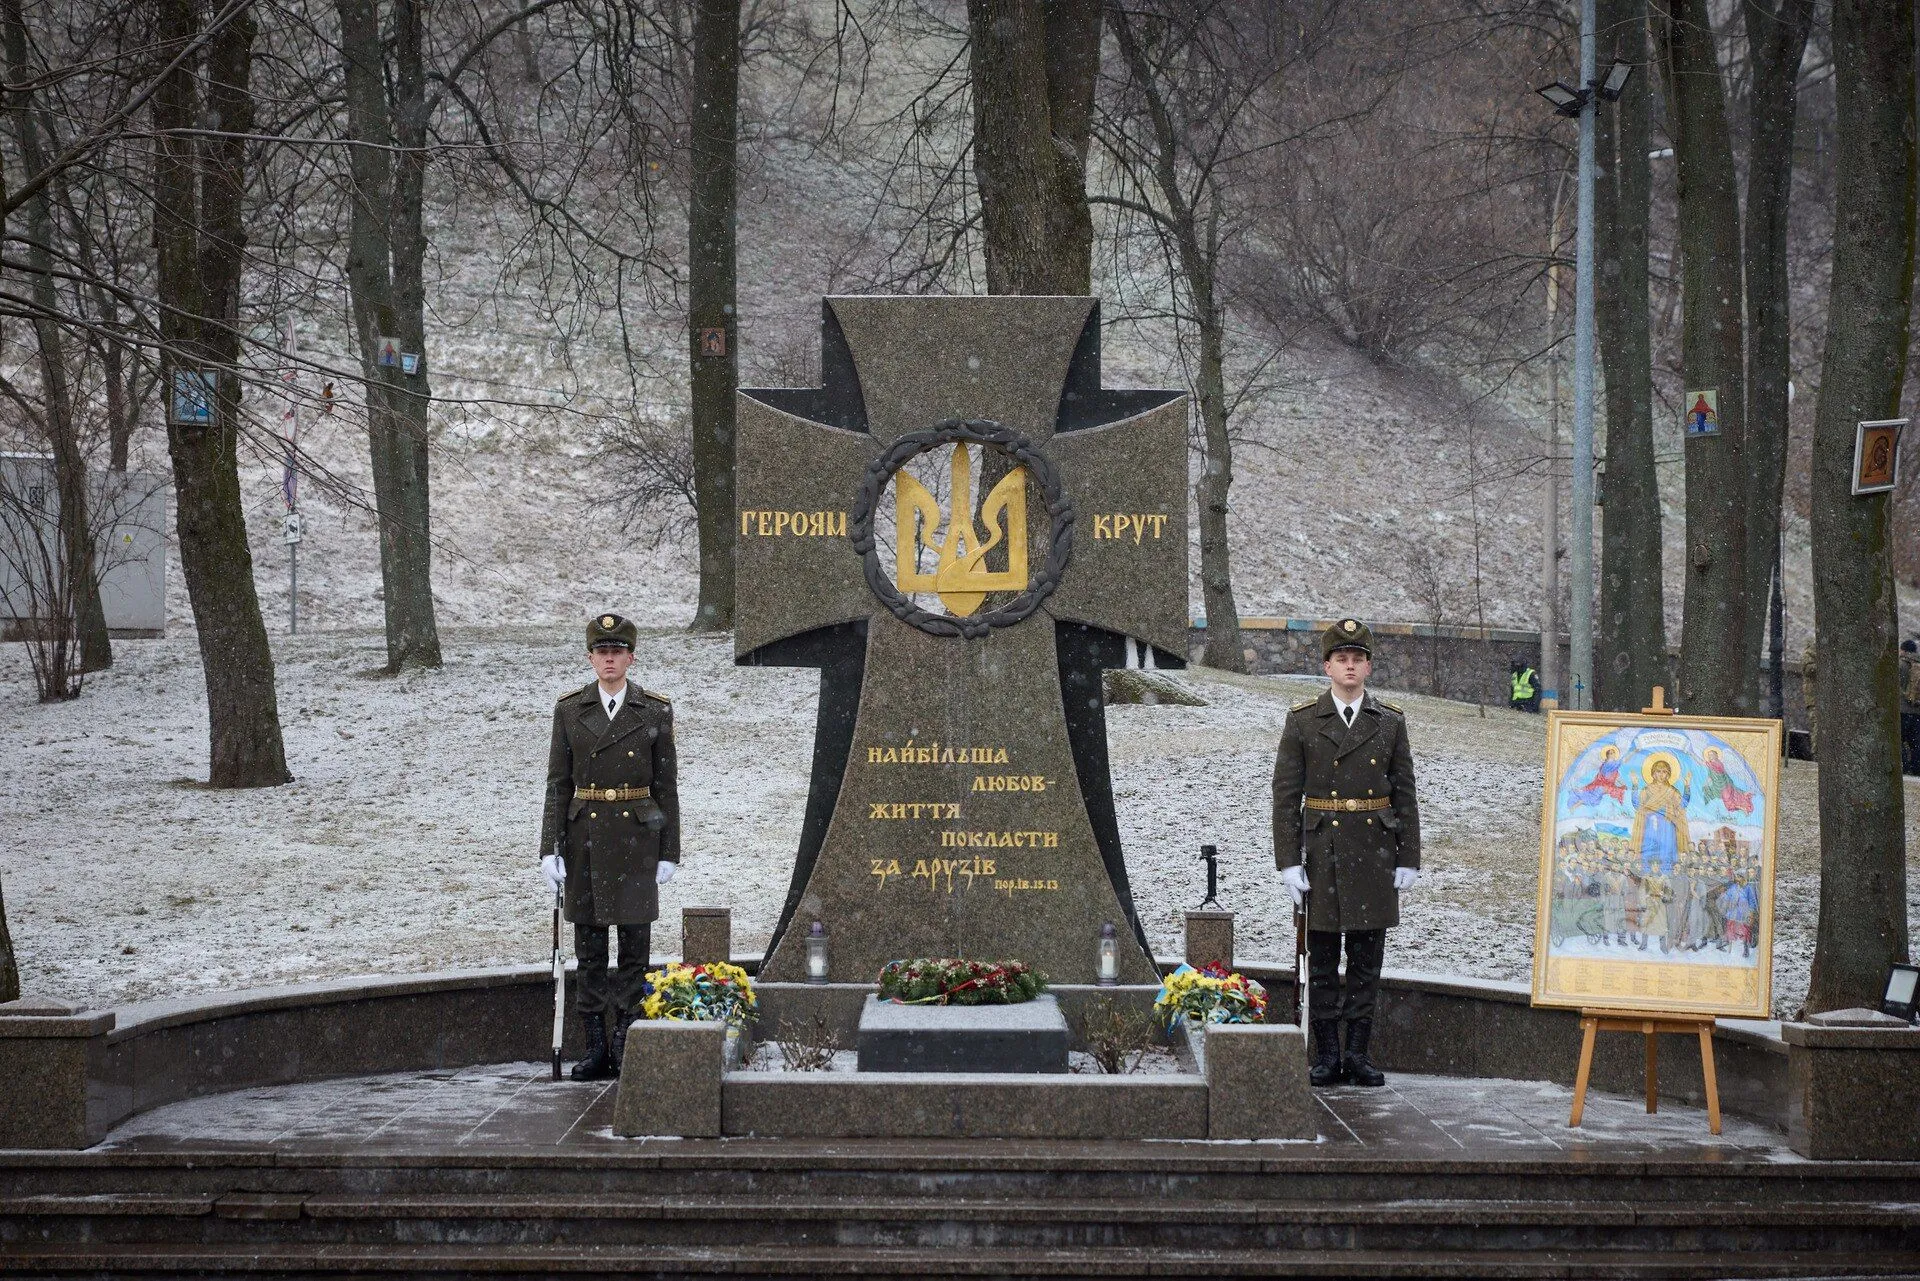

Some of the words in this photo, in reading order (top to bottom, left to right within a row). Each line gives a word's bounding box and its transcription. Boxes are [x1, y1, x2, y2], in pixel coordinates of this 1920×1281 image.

[741, 511, 847, 537] ГЕРОЯМ
[1094, 514, 1168, 545] КРУТ
[867, 740, 1009, 763] НАЙБІЛЬША
[869, 803, 961, 819] ЖИТТЯ
[941, 831, 1059, 848] ПОКЛАСТИ
[871, 858, 902, 891] ЗА
[911, 855, 997, 894] ДРУЗІВ
